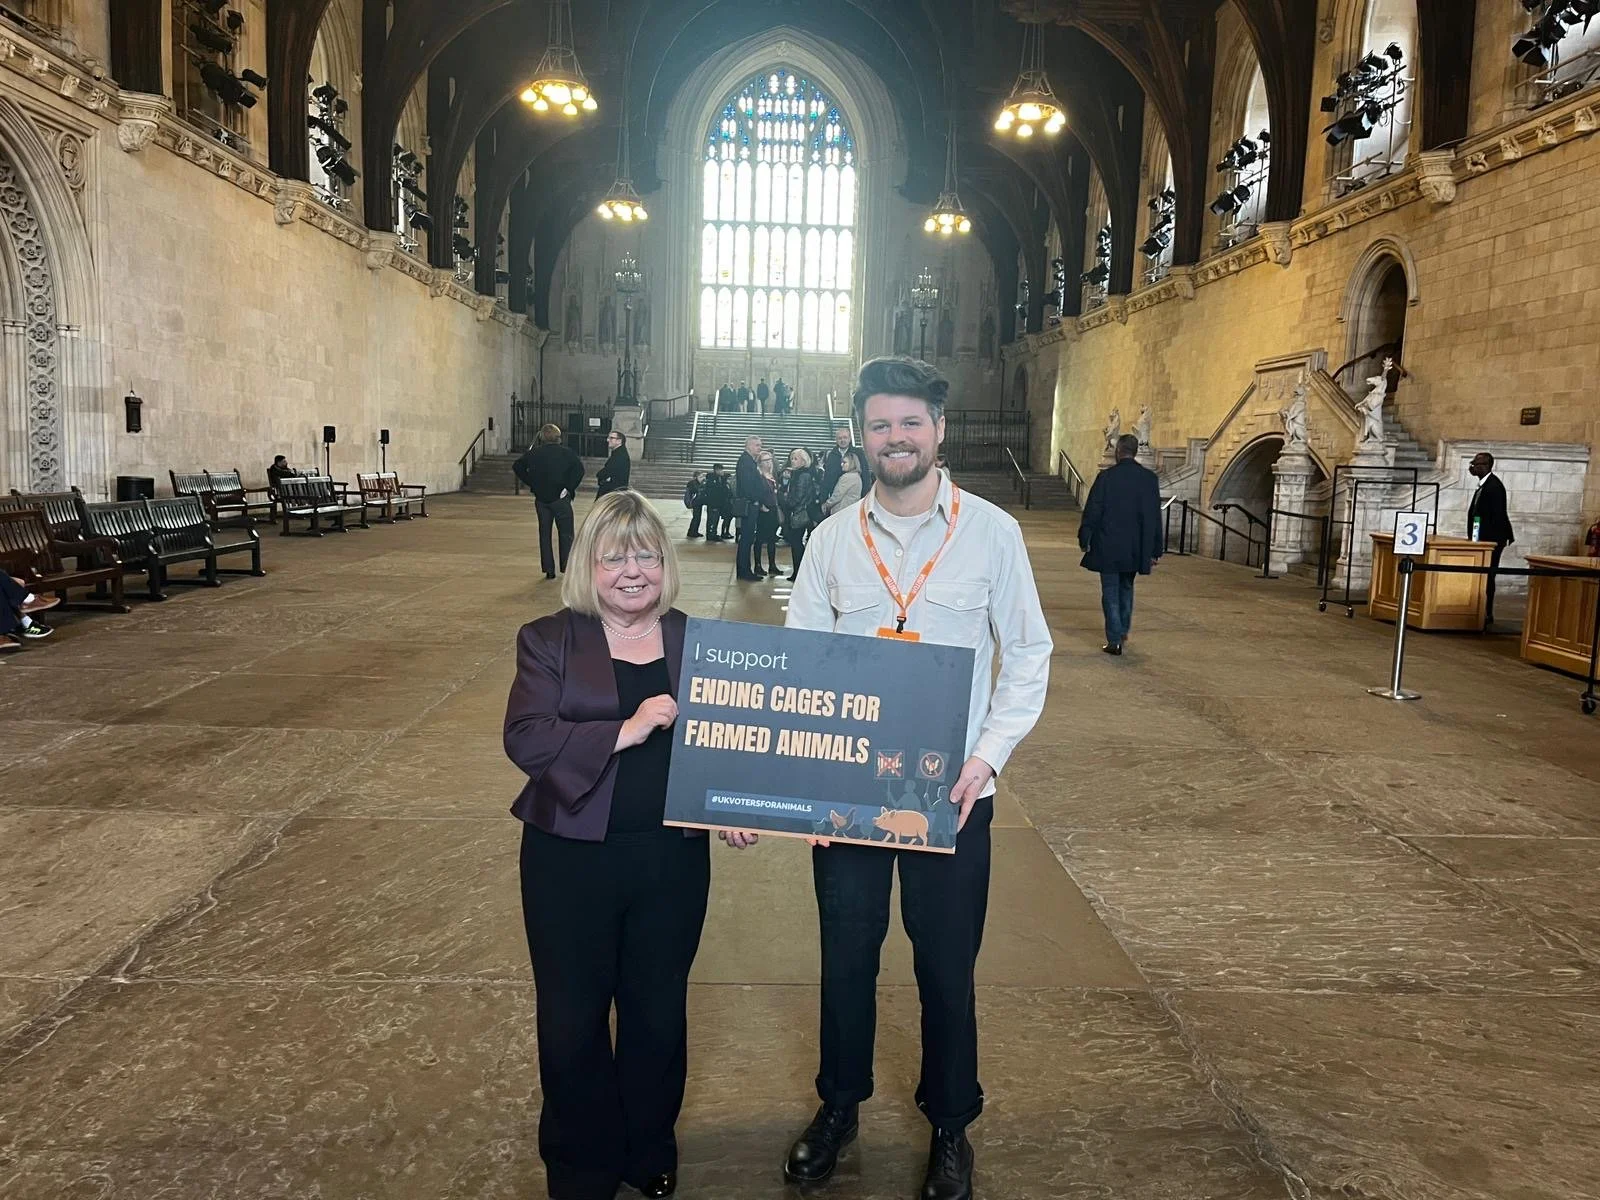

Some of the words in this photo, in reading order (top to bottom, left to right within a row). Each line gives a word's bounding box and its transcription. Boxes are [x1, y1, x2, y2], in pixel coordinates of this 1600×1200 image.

[1401, 523, 1418, 546] 3
[695, 643, 700, 661] I
[706, 648, 789, 671] support
[689, 676, 765, 710] ENDING
[770, 685, 836, 718] CAGES
[841, 693, 881, 723] FOR
[684, 719, 772, 754] FARMED
[775, 729, 870, 764] ANIMALS
[711, 795, 813, 813] #UKVOTERSFORANIMALS
